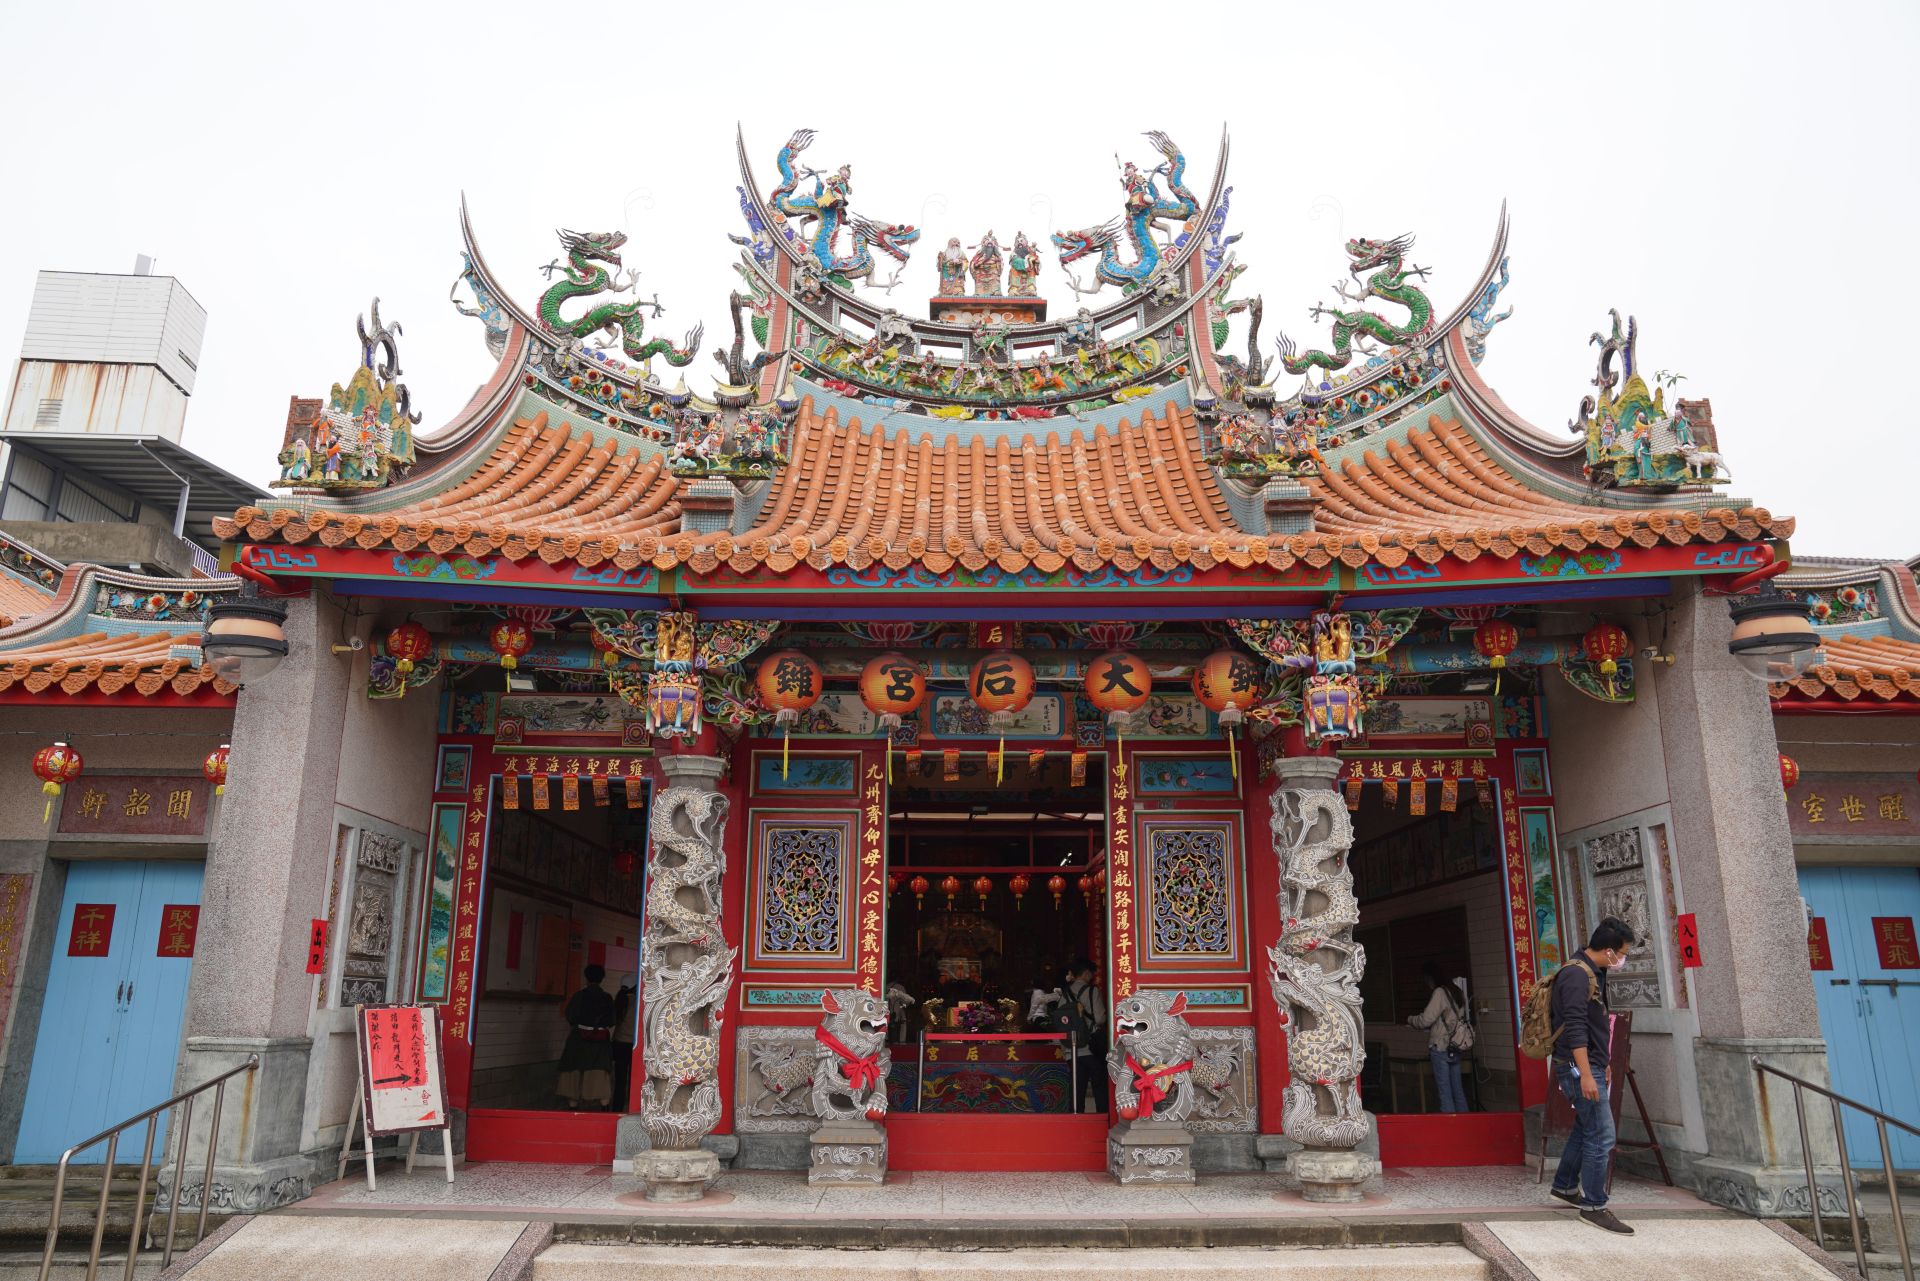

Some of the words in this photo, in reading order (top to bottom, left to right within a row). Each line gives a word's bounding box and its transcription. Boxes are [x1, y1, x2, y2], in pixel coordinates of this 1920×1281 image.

[986, 625, 1004, 643] 后
[879, 659, 923, 702] 宮
[975, 655, 1017, 698] 后
[1100, 654, 1144, 697] 天
[76, 788, 193, 820] 聞韶軒
[1801, 792, 1912, 823] 醒世室
[75, 908, 105, 951] 千祥
[164, 909, 193, 954] 聚集
[313, 927, 322, 964] 出口
[1682, 923, 1695, 959] 入口
[1881, 922, 1915, 966] 龍飛
